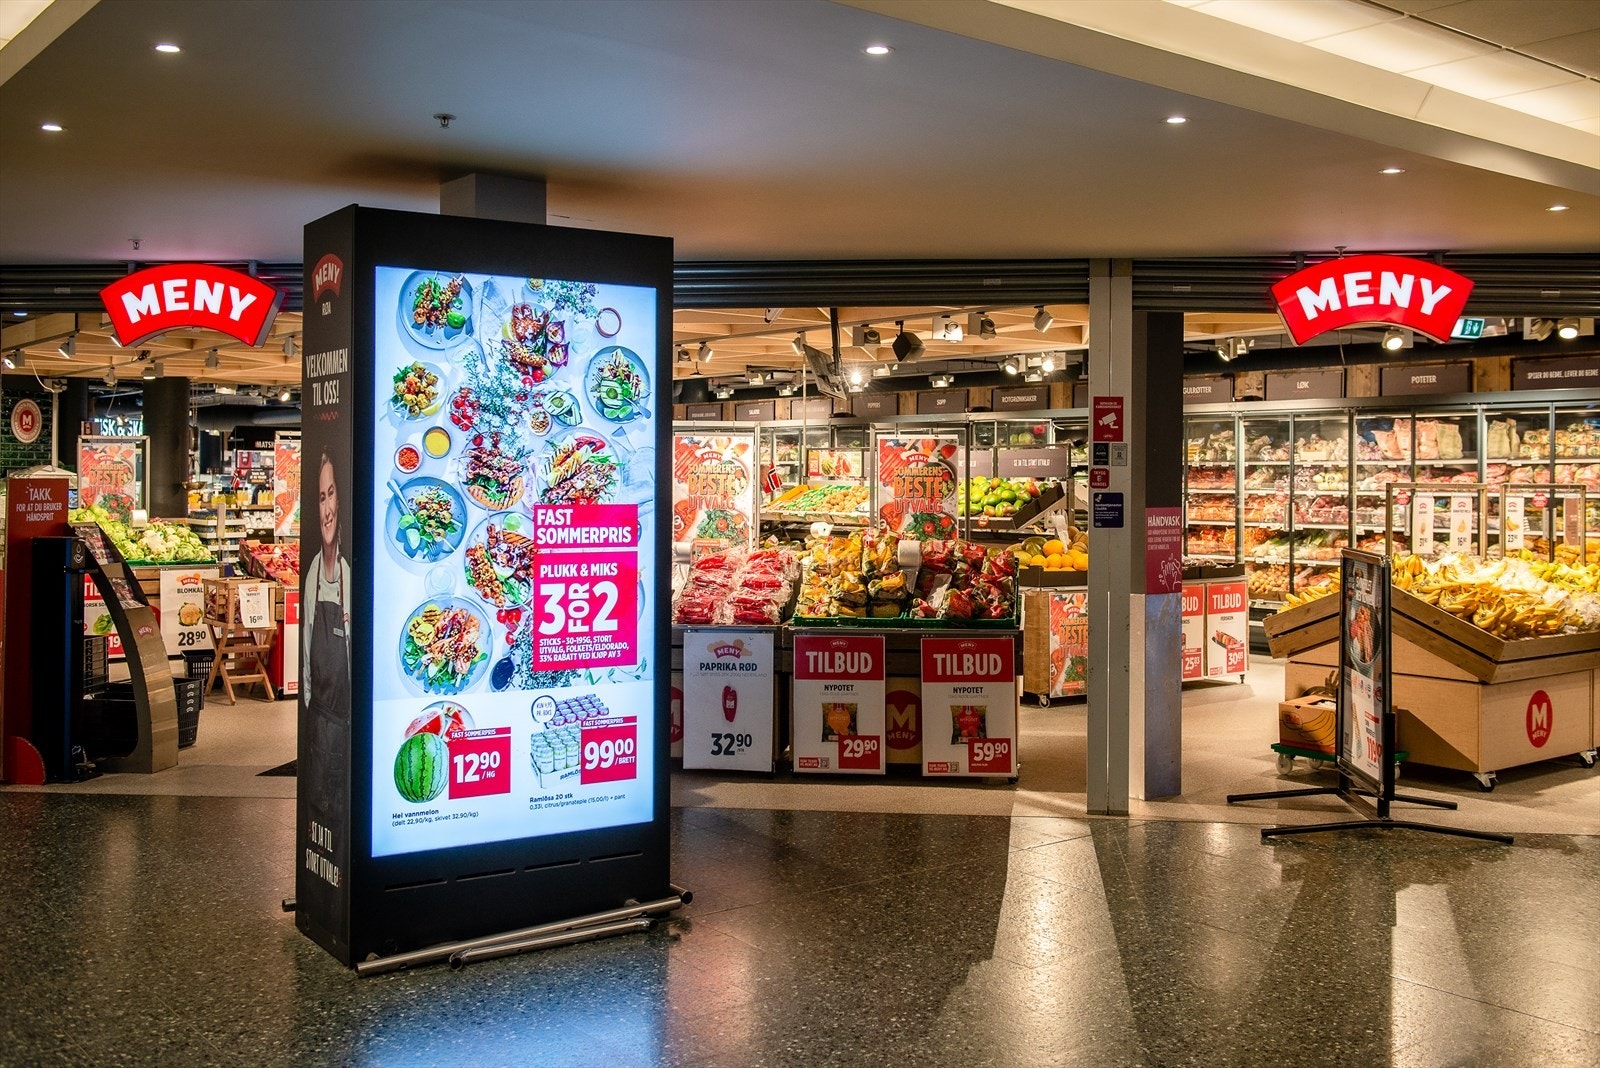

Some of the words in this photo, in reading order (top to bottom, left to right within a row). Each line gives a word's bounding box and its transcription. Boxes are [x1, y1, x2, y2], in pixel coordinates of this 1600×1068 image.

[315, 262, 340, 291] MENY
[121, 278, 257, 324] MENY
[1296, 271, 1452, 320] MENY
[306, 348, 348, 379] VELKOMMEN
[1296, 381, 1309, 389] LØK
[1411, 375, 1437, 384] POTETER
[313, 381, 323, 406] TIL
[323, 379, 340, 404] OSS!
[1183, 386, 1212, 395] GULRØTTER
[95, 418, 116, 437] ISK
[88, 470, 125, 486] BESTE
[894, 466, 943, 477] SOMMERENS
[688, 473, 737, 496] BESTE
[894, 476, 943, 498] BESTE
[16, 503, 26, 512] FOR
[27, 503, 34, 511] AT
[35, 503, 42, 512] DU
[43, 502, 62, 511] BRUKER
[689, 495, 736, 511] UTVALG
[894, 498, 943, 514] UTVALG
[26, 512, 54, 522] HÅNDSPRIT
[537, 508, 573, 526] FAST
[1147, 515, 1180, 527] HÅNDVASK
[536, 526, 632, 545] SOMMERPRIS
[540, 564, 576, 578] PLUKK
[580, 563, 588, 577] &
[590, 563, 618, 577] MIKS
[538, 583, 566, 635] 3
[568, 582, 590, 633] FOR
[592, 581, 619, 632] 2
[1212, 593, 1242, 610] TILBUD
[540, 638, 561, 647] STICKS
[593, 634, 613, 643] STORT
[539, 646, 565, 655] UTVALG,
[539, 654, 553, 663] 33%
[553, 652, 577, 662] RABATT
[579, 652, 590, 660] VED
[591, 650, 607, 659] KJØP
[608, 650, 617, 658] AV
[717, 647, 740, 655] MENY
[700, 662, 737, 671] PAPRIKA
[739, 662, 758, 672] RØD
[805, 651, 873, 674] TILBUD
[933, 653, 1002, 676] TILBUD
[952, 686, 983, 694] NYPOTET
[595, 717, 624, 726] SOMMERPRIS
[886, 703, 917, 732] M
[1531, 702, 1548, 731] M
[464, 728, 497, 738] SOMMERPRIS
[887, 731, 916, 740] MENY
[1532, 730, 1547, 740] MENY
[529, 794, 554, 803] Ramlösa
[614, 793, 626, 802] pant
[391, 818, 406, 828] (delt
[434, 813, 451, 822] skivet
[392, 812, 403, 820] Hel
[404, 809, 440, 818] vannmelon
